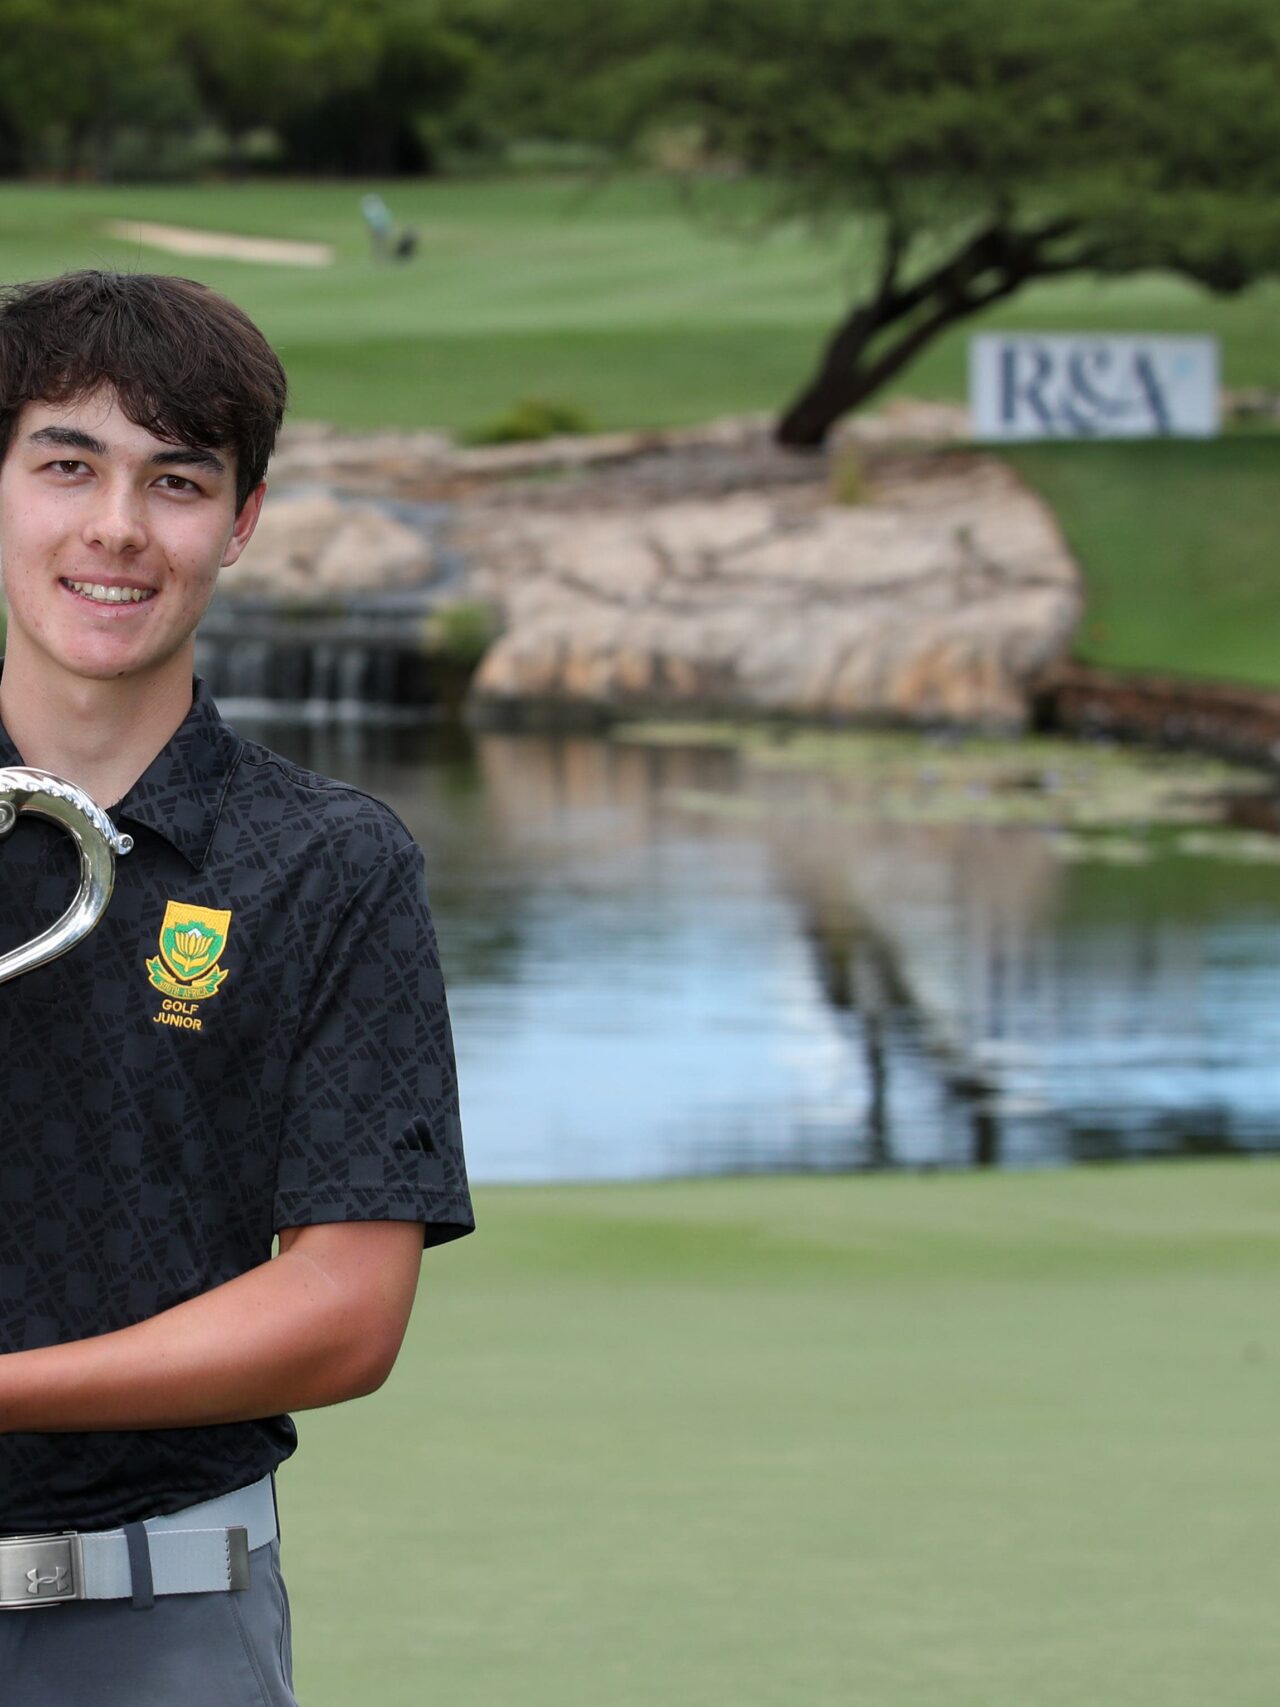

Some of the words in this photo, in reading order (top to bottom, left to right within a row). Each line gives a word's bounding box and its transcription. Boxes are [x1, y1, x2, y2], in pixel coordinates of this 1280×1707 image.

[999, 344, 1173, 437] R&A
[158, 980, 180, 995] SOUTH
[183, 986, 209, 997] AFRICA
[162, 999, 199, 1015] GOLF
[153, 1012, 202, 1030] JUNIOR
